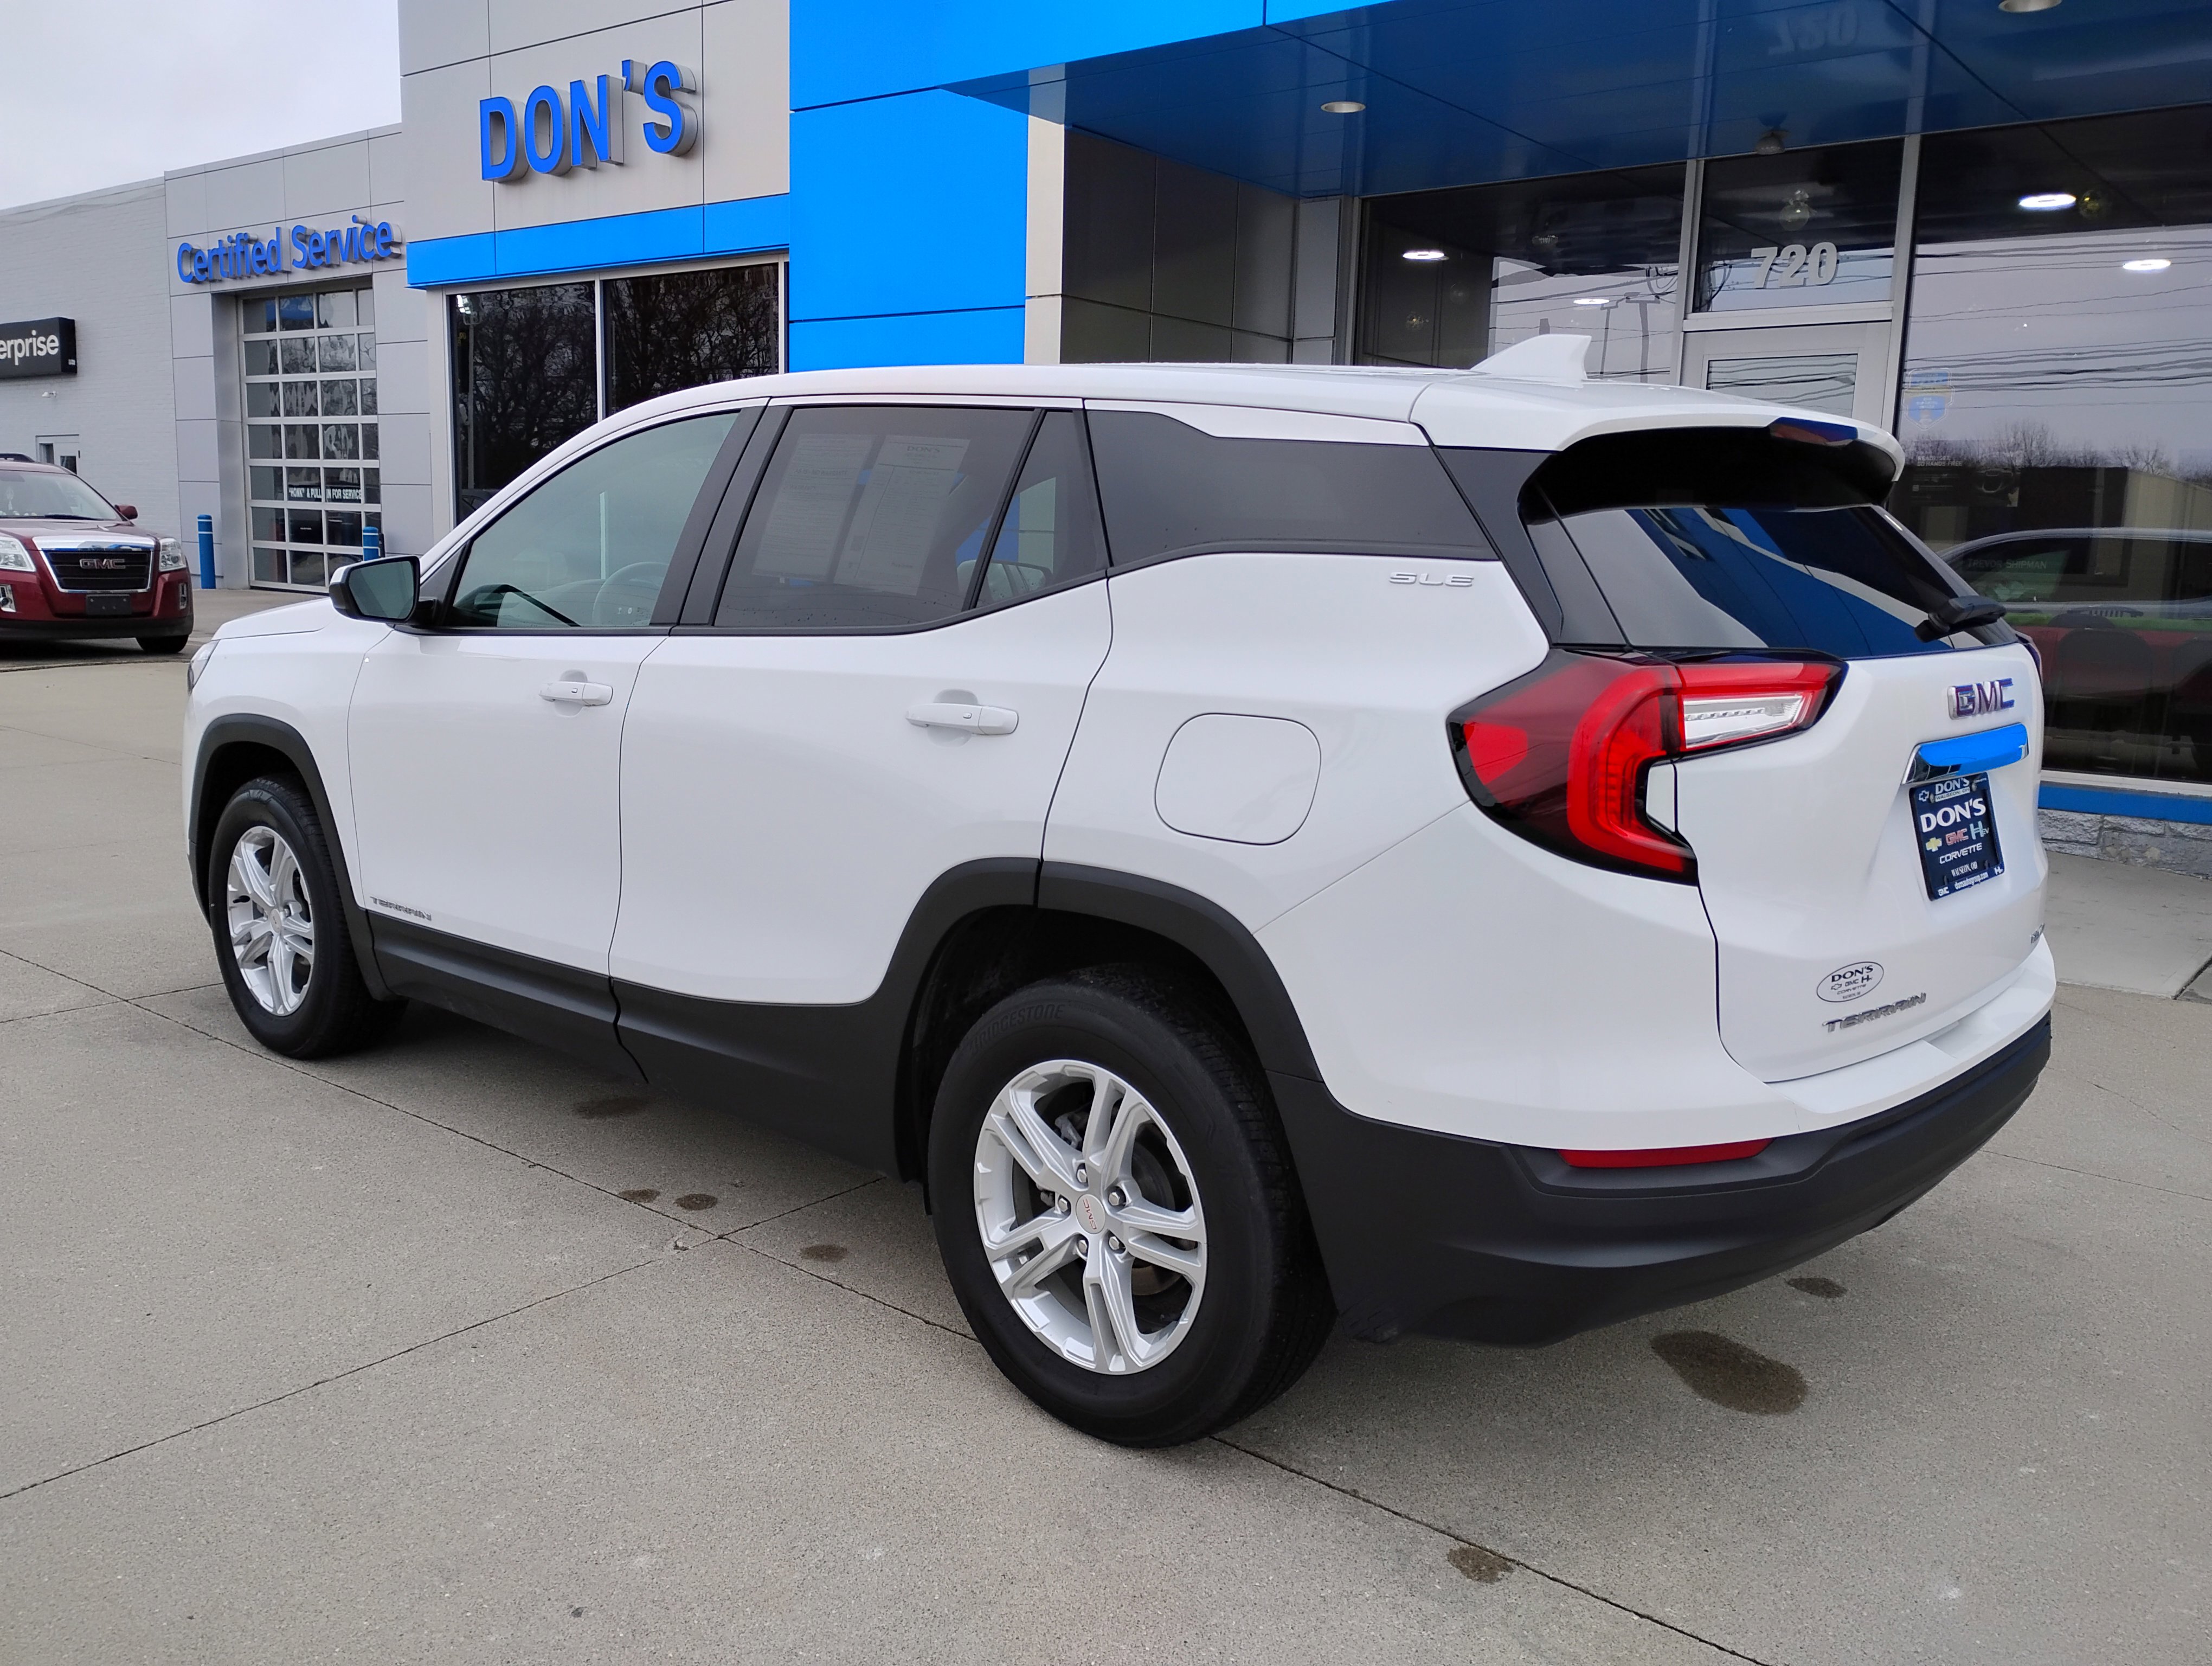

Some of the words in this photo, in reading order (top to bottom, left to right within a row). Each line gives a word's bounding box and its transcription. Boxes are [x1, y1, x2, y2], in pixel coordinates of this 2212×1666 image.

[479, 59, 684, 181] DON'S
[177, 226, 282, 283] Certified
[291, 214, 393, 269] Service
[1751, 242, 1837, 289] 720
[311, 488, 321, 498] PULL
[326, 489, 331, 499] IN
[332, 489, 342, 499] FOR
[79, 559, 125, 569] GMC
[1968, 559, 2002, 569] TREVOR
[2006, 559, 2047, 569] SHIPMAN
[1389, 572, 1474, 587] SLE
[1947, 678, 2015, 720] GMC
[1935, 777, 1970, 794] DON'S
[1920, 798, 1986, 832] DON'S
[1945, 828, 1969, 845] GMC
[1939, 843, 1983, 864] CORVETTE
[370, 895, 432, 921] TERRAIN
[1831, 965, 1874, 983] DON'S
[1822, 992, 1927, 1033] TERRAIN
[1083, 1198, 1098, 1230] GMC
